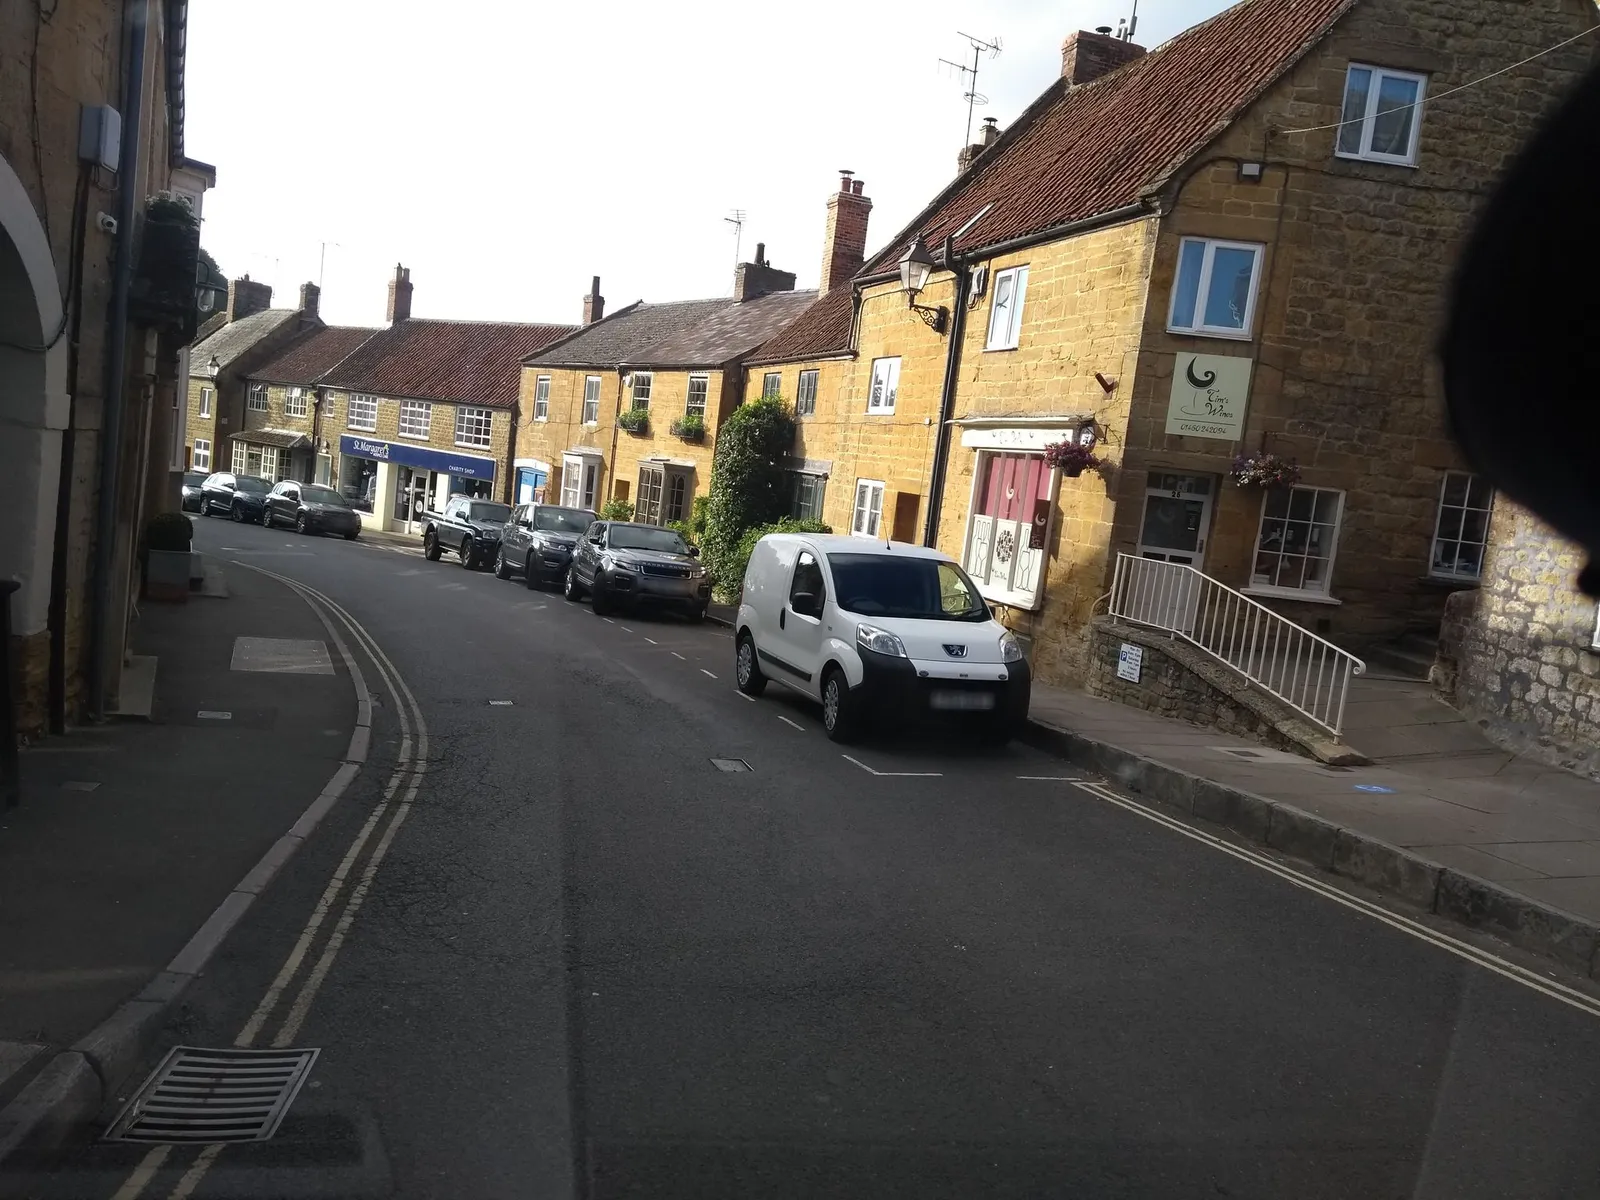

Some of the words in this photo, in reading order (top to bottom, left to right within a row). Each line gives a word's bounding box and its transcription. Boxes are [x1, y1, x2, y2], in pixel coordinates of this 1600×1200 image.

[1207, 388, 1229, 404] Tim's
[1205, 402, 1233, 418] Wines
[448, 465, 464, 473] CHARITY
[464, 467, 475, 475] SHOP
